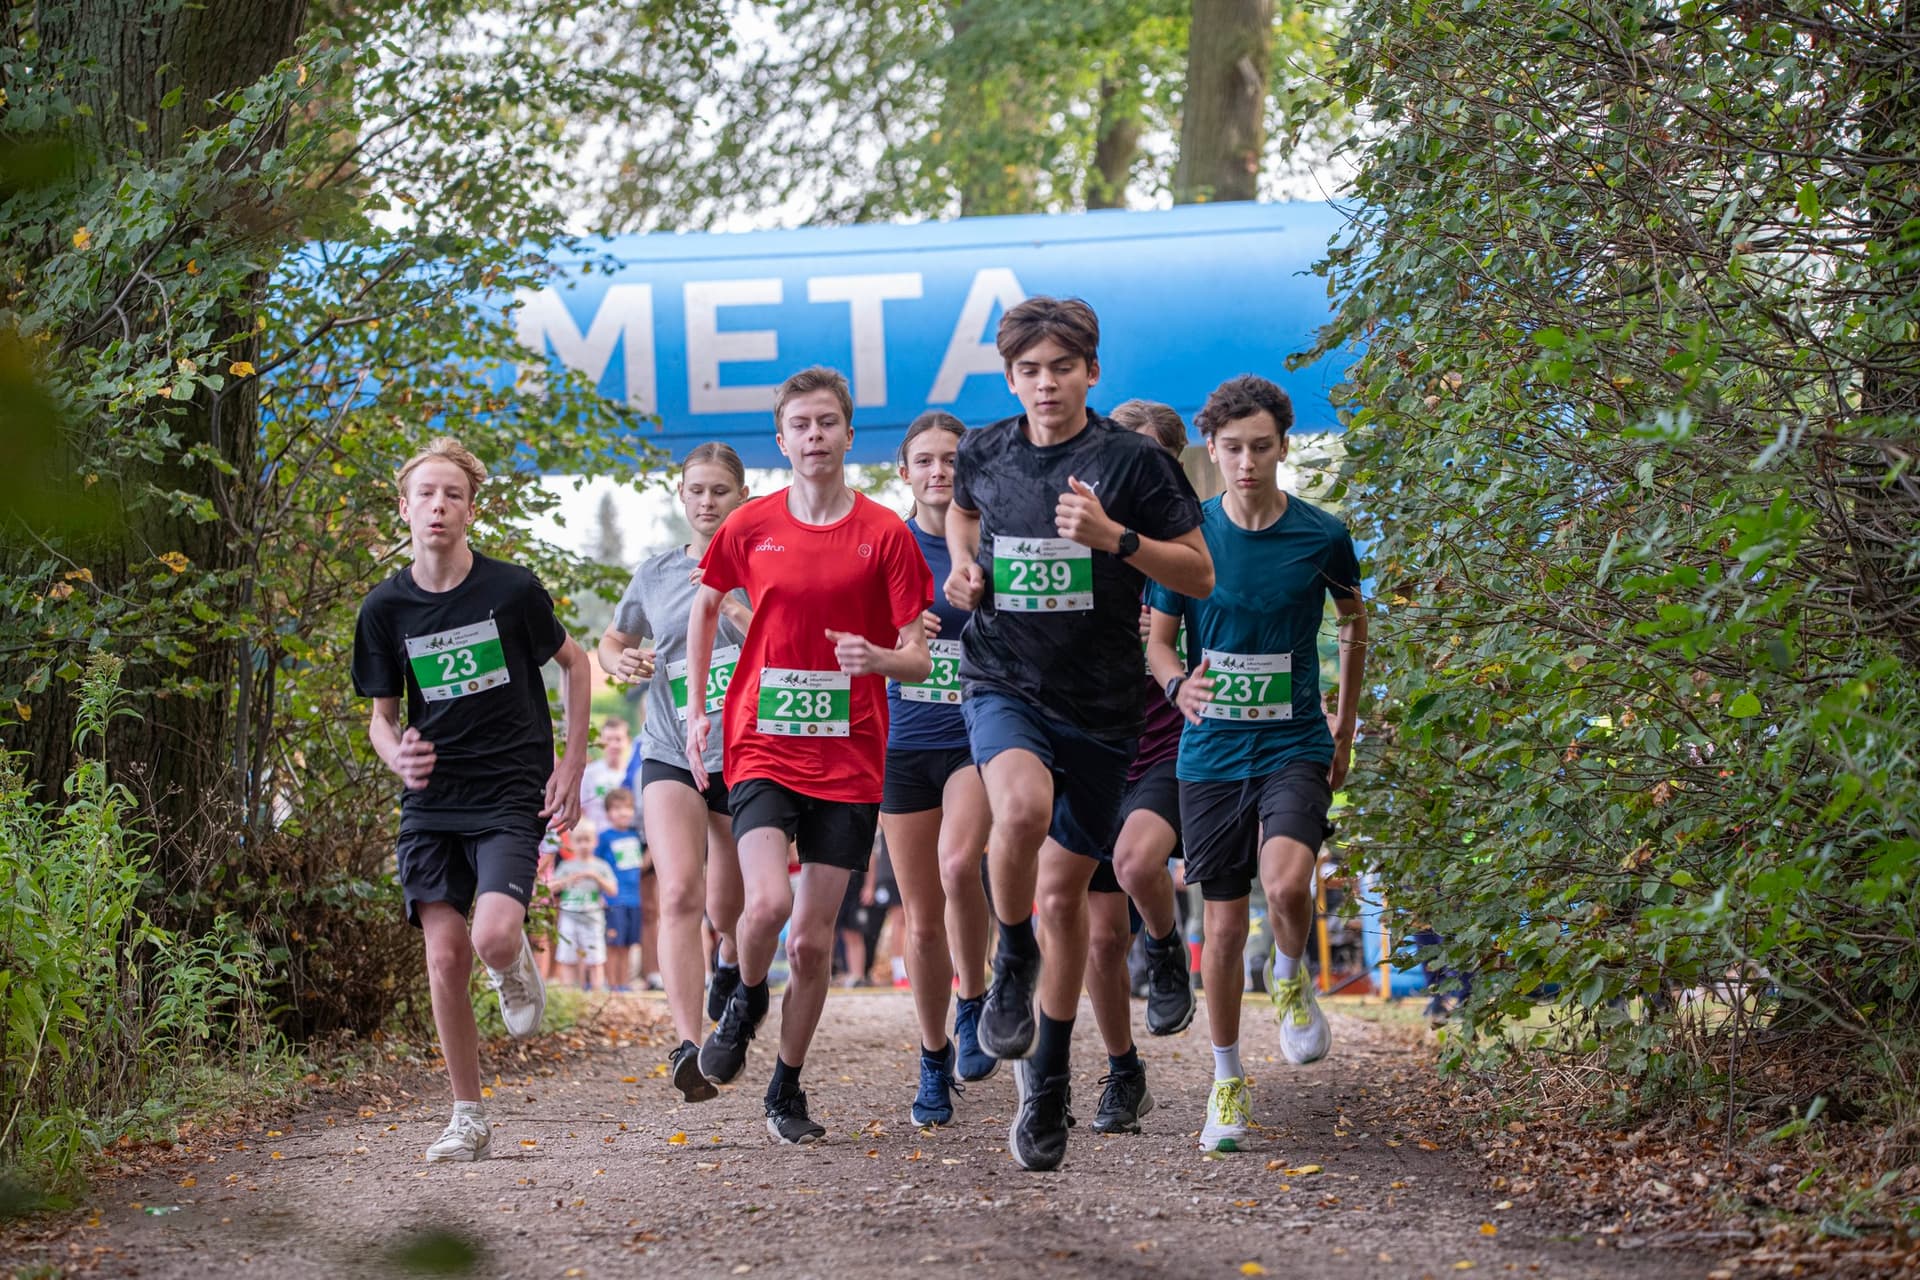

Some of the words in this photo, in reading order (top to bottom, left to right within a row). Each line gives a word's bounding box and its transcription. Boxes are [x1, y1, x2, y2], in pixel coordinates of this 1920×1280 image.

[513, 268, 1028, 415] META
[1009, 560, 1072, 592] 239
[437, 648, 478, 681] 23
[774, 689, 832, 719] 238
[1215, 673, 1273, 703] 237
